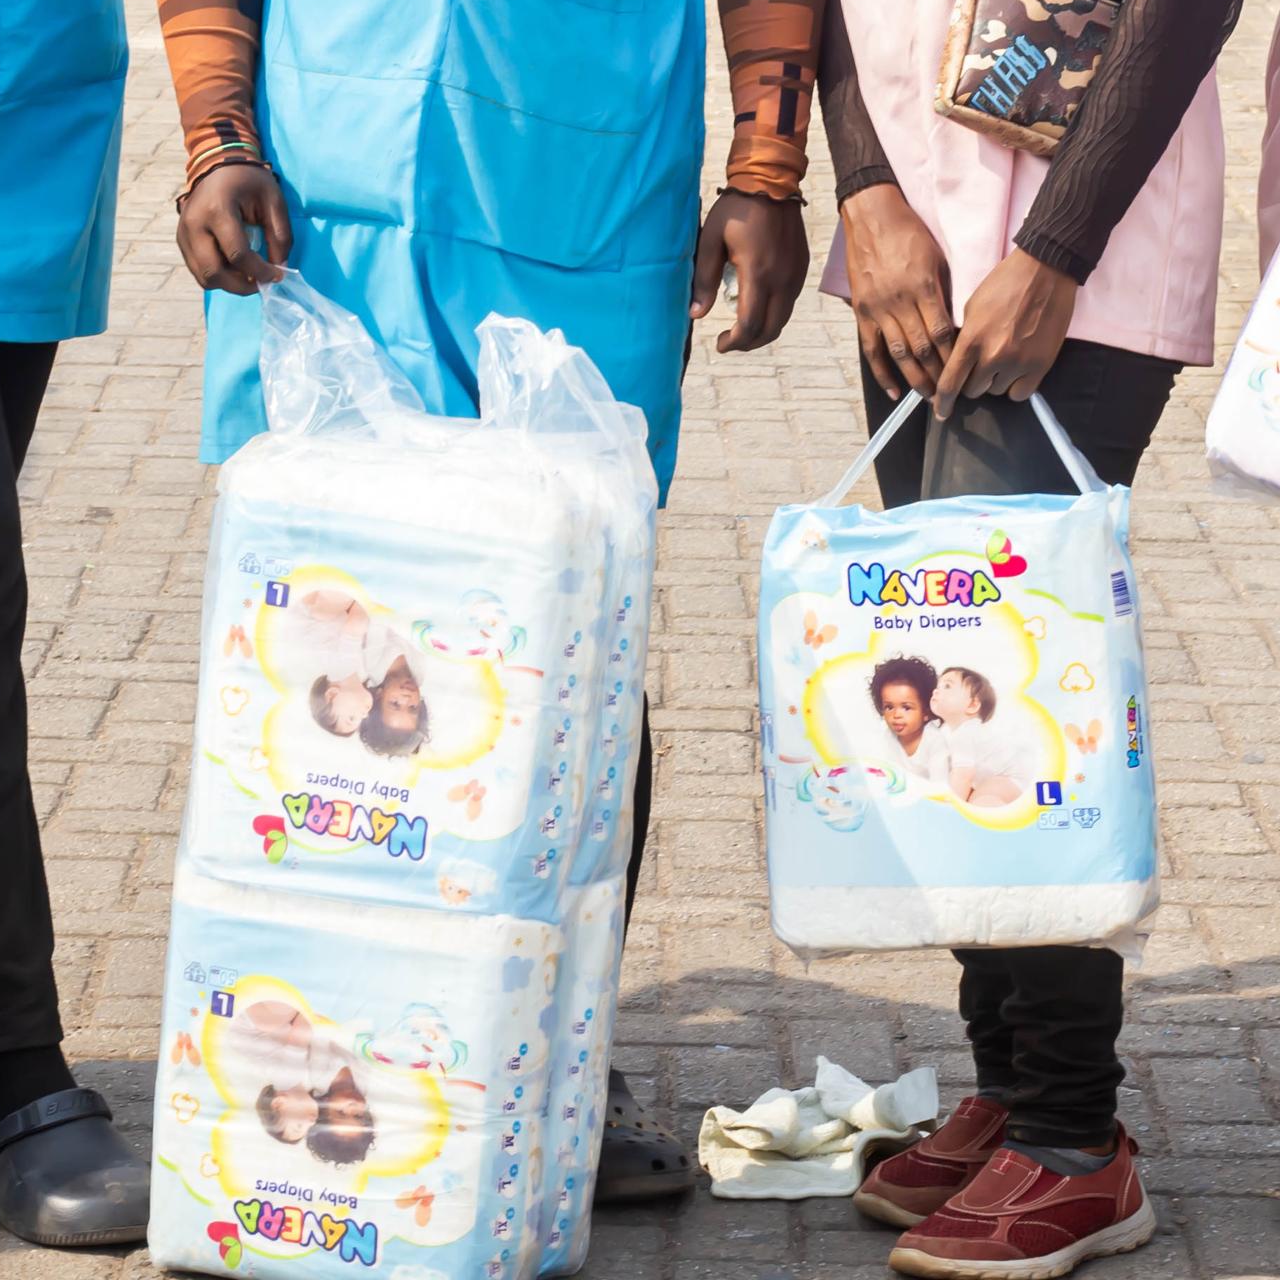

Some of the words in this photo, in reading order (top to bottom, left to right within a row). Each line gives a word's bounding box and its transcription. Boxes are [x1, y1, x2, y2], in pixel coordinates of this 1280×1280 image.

[847, 563, 1001, 607] NAVERA
[874, 615, 913, 632] Baby
[919, 613, 982, 630] Diapers
[306, 770, 366, 795] Diapers
[370, 781, 410, 803] Baby
[1042, 782, 1057, 805] L
[282, 792, 429, 861] NAVERA
[255, 1180, 313, 1202] Diapers
[317, 1187, 358, 1209] Baby
[234, 1199, 377, 1266] NAVERA
